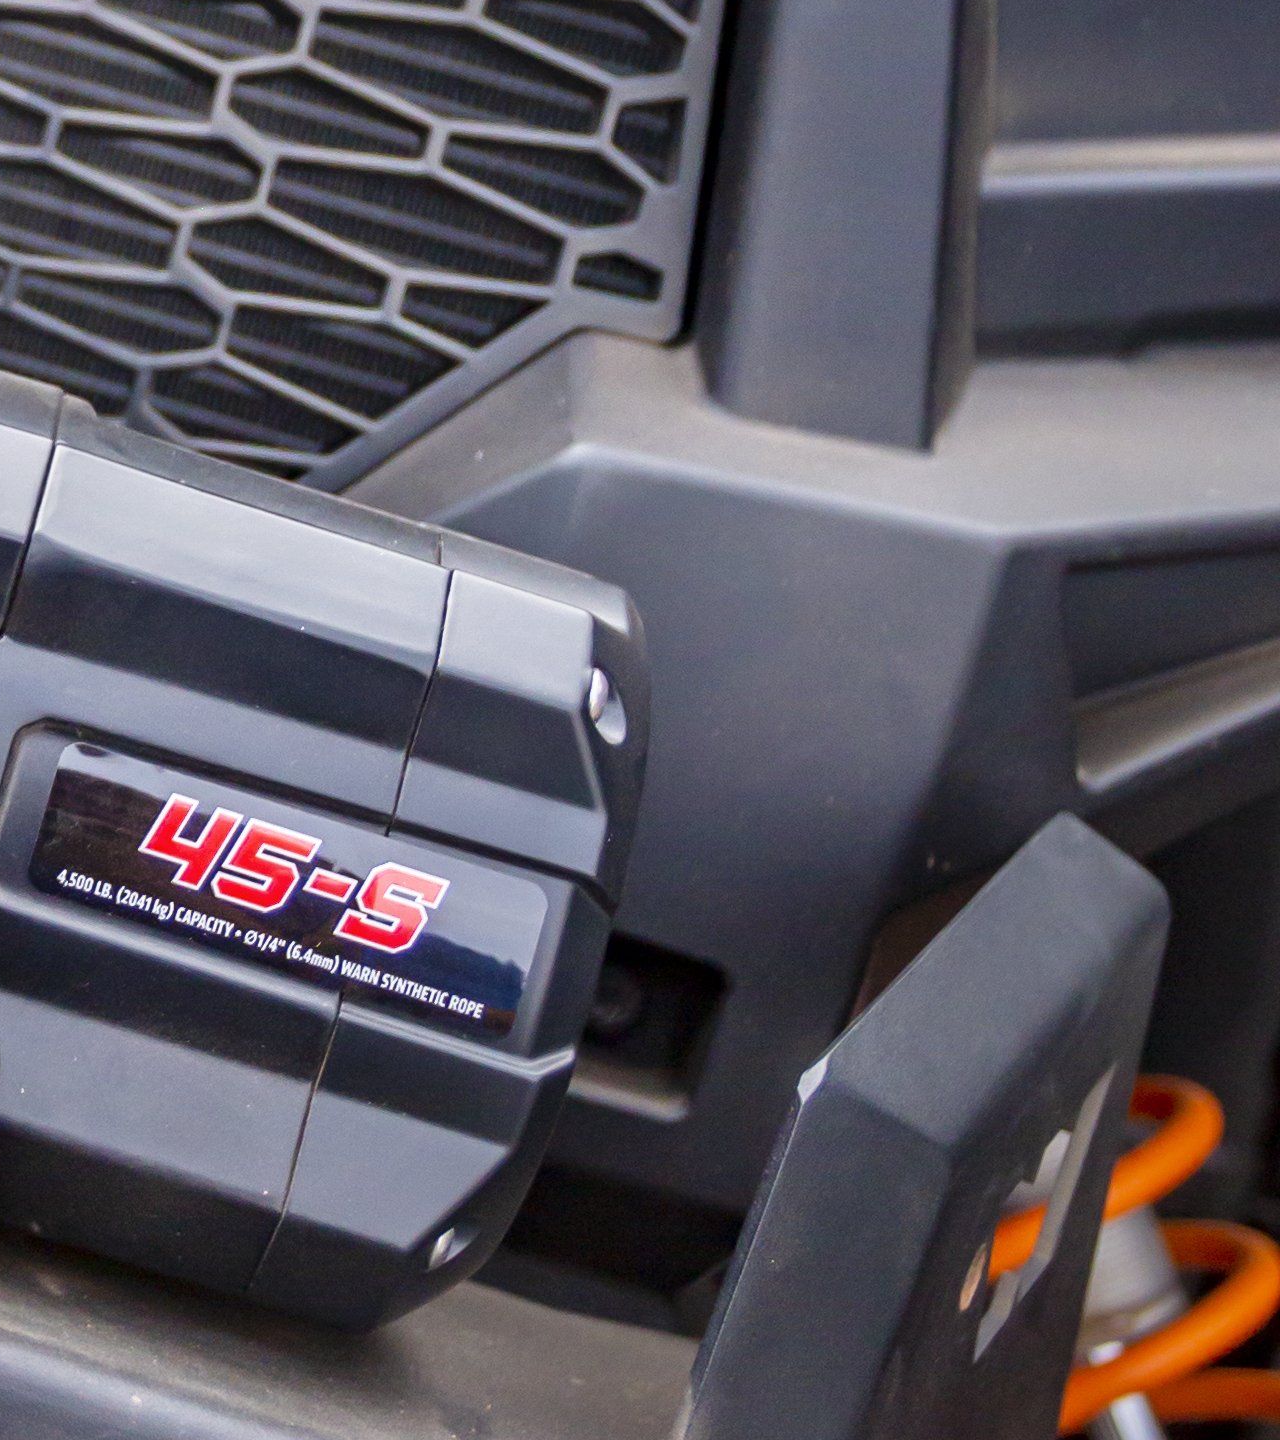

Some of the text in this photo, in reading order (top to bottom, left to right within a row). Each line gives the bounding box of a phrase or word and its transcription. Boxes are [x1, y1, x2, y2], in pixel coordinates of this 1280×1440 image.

[56, 869, 93, 892] 4,500
[94, 879, 113, 899] LB.
[115, 886, 152, 914] (2041
[152, 898, 175, 921] kg)
[174, 906, 235, 938] CAPACITY
[285, 940, 340, 974] (6.4mm)
[340, 959, 381, 986] WARN
[380, 973, 450, 1008] SYNTHETIC
[449, 994, 485, 1019] ROPE
[137, 792, 451, 954] 45-S
